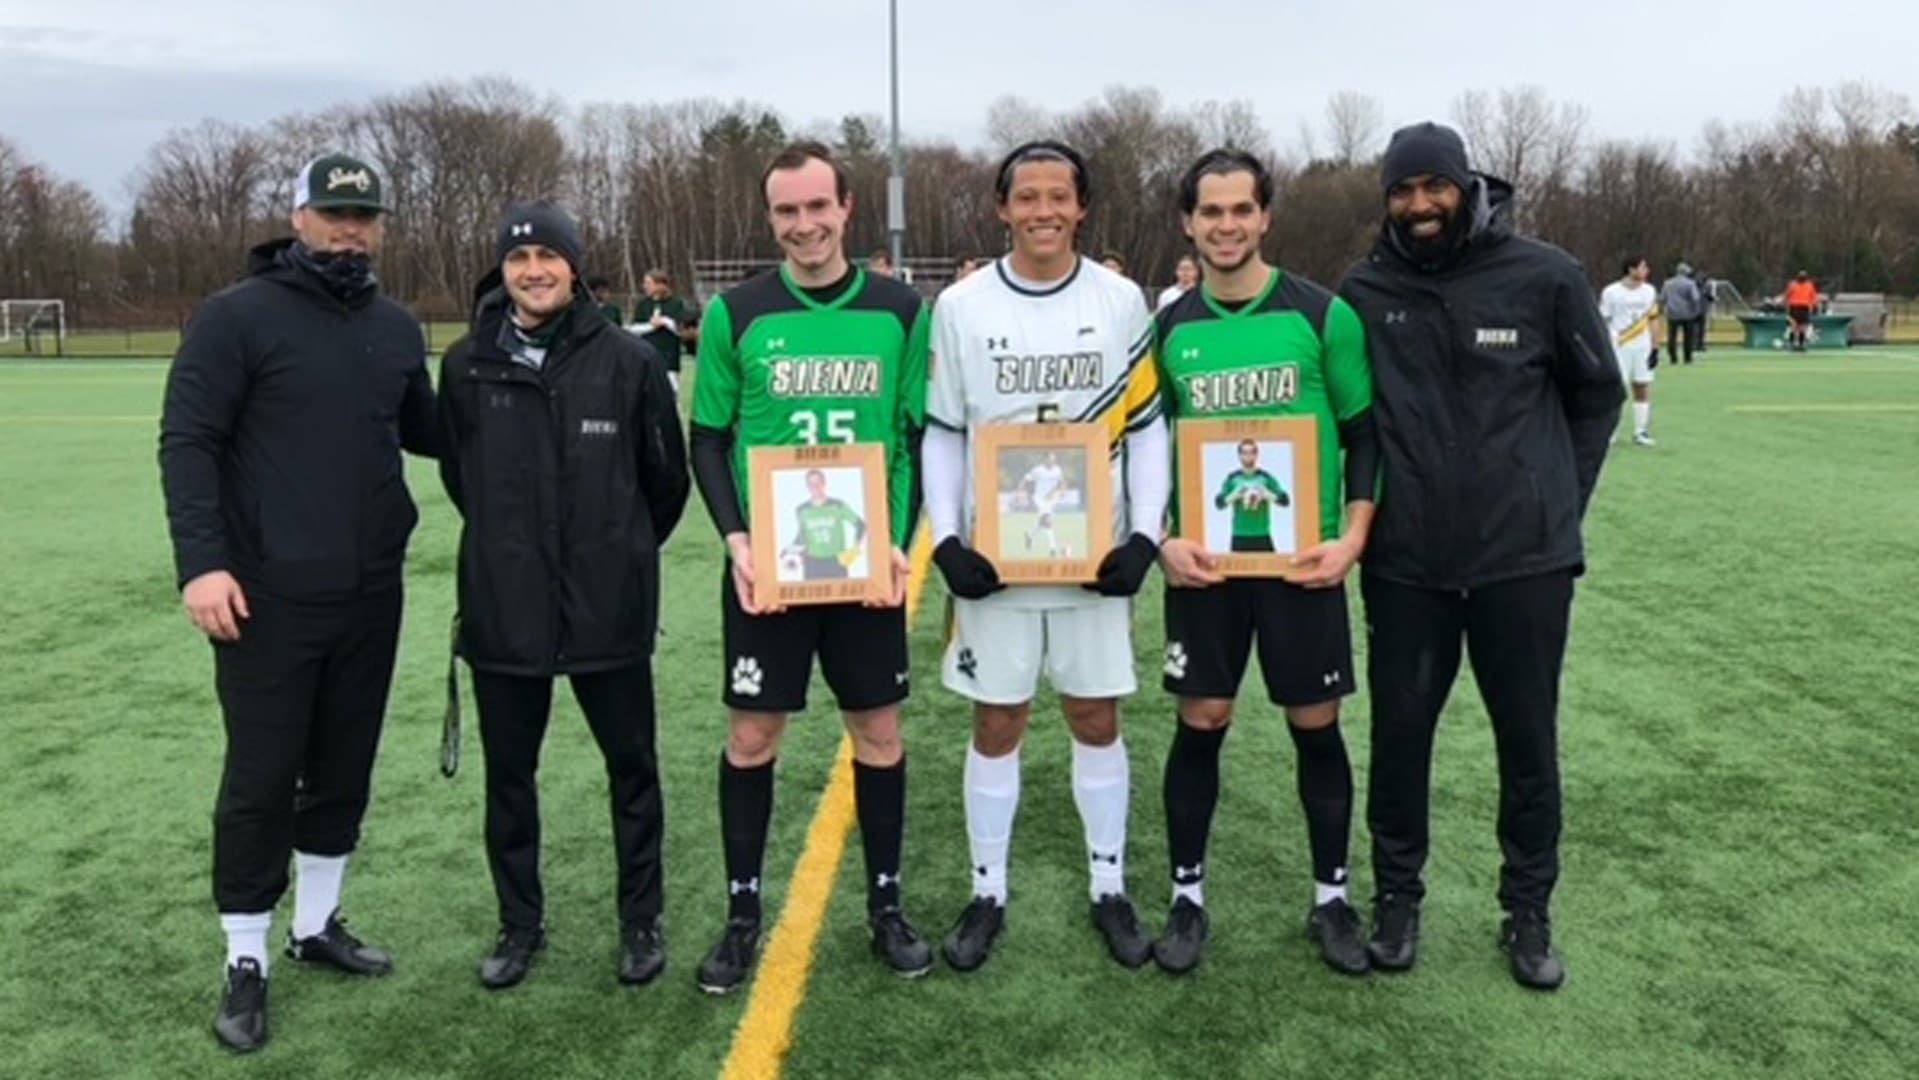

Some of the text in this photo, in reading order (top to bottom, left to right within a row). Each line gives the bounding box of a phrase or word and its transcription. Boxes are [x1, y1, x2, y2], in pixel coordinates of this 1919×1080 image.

[770, 356, 882, 397] SIENA
[996, 353, 1103, 394] SIENA
[1189, 364, 1298, 411] SIENA
[789, 410, 857, 445] 35
